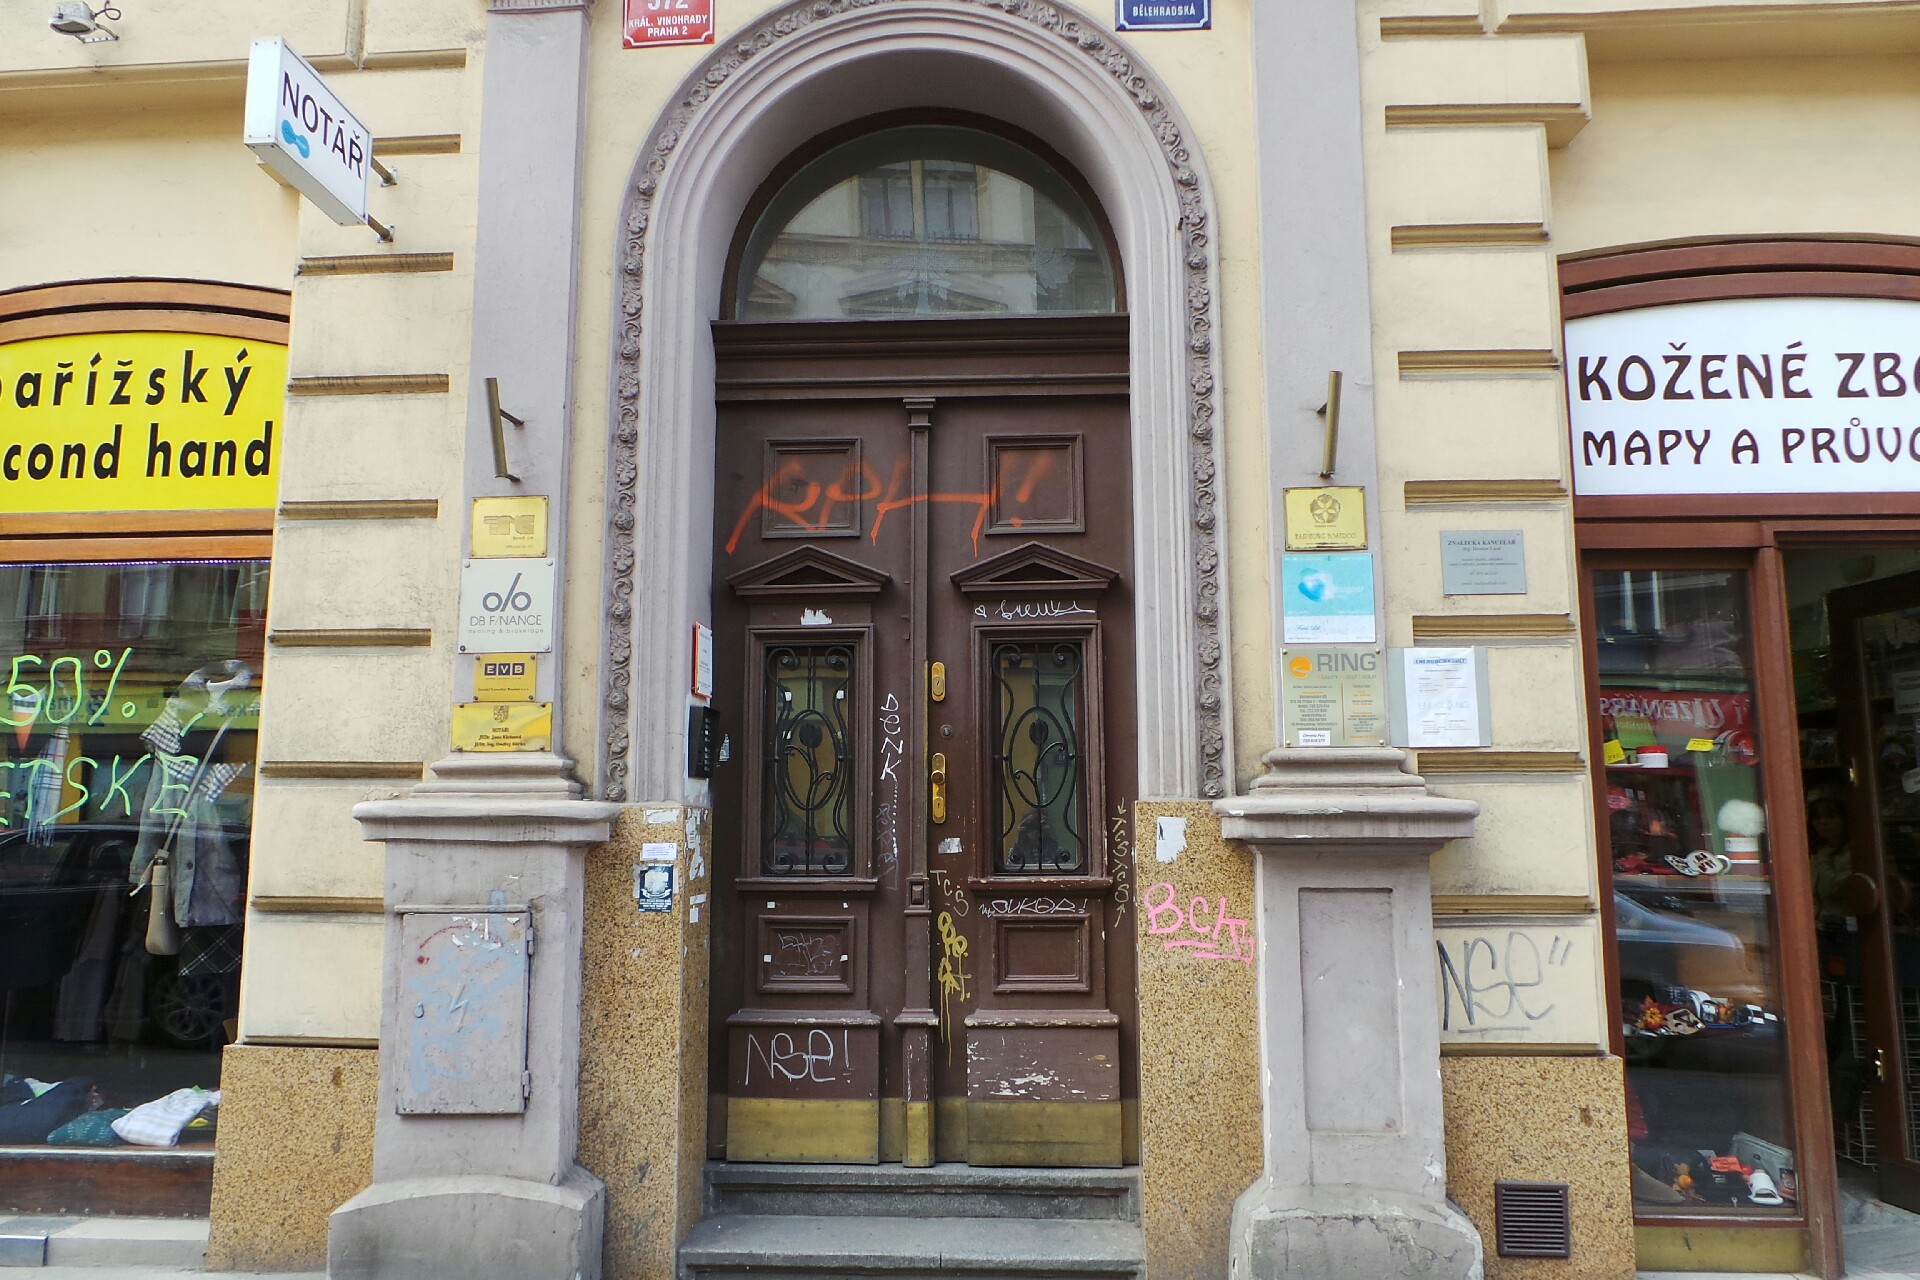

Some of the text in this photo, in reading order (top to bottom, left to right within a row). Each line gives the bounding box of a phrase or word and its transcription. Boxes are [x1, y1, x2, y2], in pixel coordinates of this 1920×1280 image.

[1132, 3, 1196, 17] BĚLEHRADSKÁ
[628, 14, 708, 28] KRÁL. VINOHRADY
[647, 26, 688, 38] PRAHA 2
[282, 70, 363, 180] NOTÁŘ
[1578, 340, 1920, 401] KOŽENÉ ZB
[0, 347, 252, 416] ařížský
[145, 420, 274, 477] hand
[1582, 428, 1711, 466] MAPY
[1731, 428, 1760, 465] A
[469, 616, 486, 627] DB
[485, 664, 524, 675] EVB
[1316, 652, 1377, 672] RING
